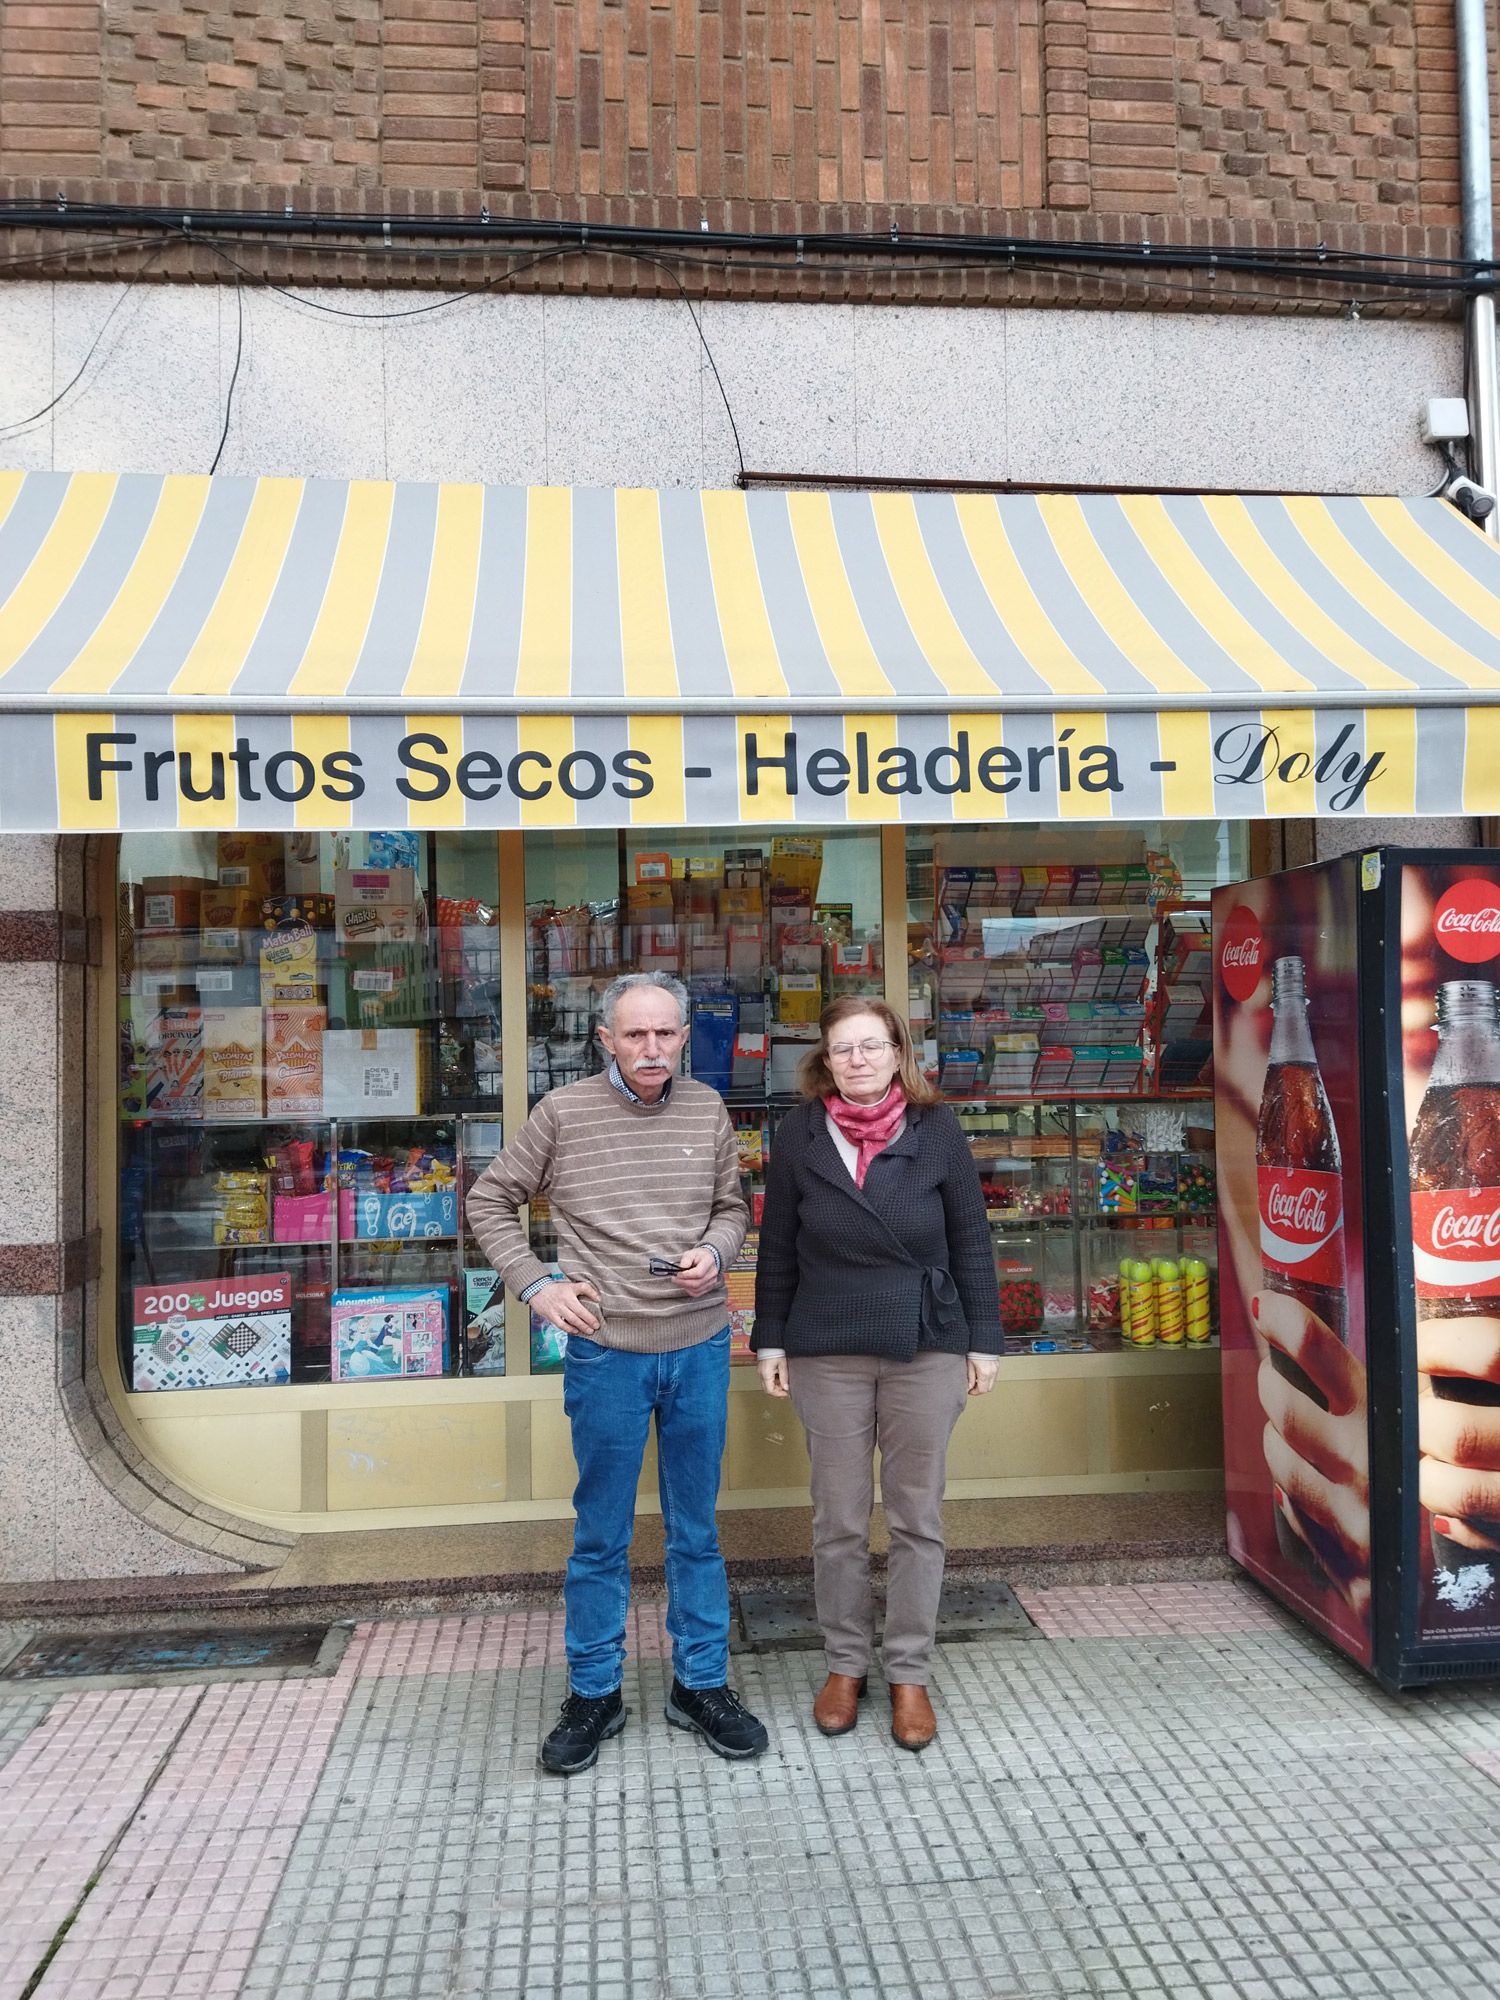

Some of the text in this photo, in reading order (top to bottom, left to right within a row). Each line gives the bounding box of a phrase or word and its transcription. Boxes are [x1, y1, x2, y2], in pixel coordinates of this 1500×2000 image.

[86, 732, 366, 803] Frutos
[395, 732, 655, 802] Secos
[745, 728, 1124, 797] Heladería
[1213, 722, 1388, 813] Doly
[1222, 936, 1262, 968] Coca-Cola
[212, 1052, 254, 1063] PALOMITAS
[1268, 1183, 1327, 1233] Coca-Cola
[143, 1294, 189, 1315] 200
[208, 1288, 284, 1309] Juegos
